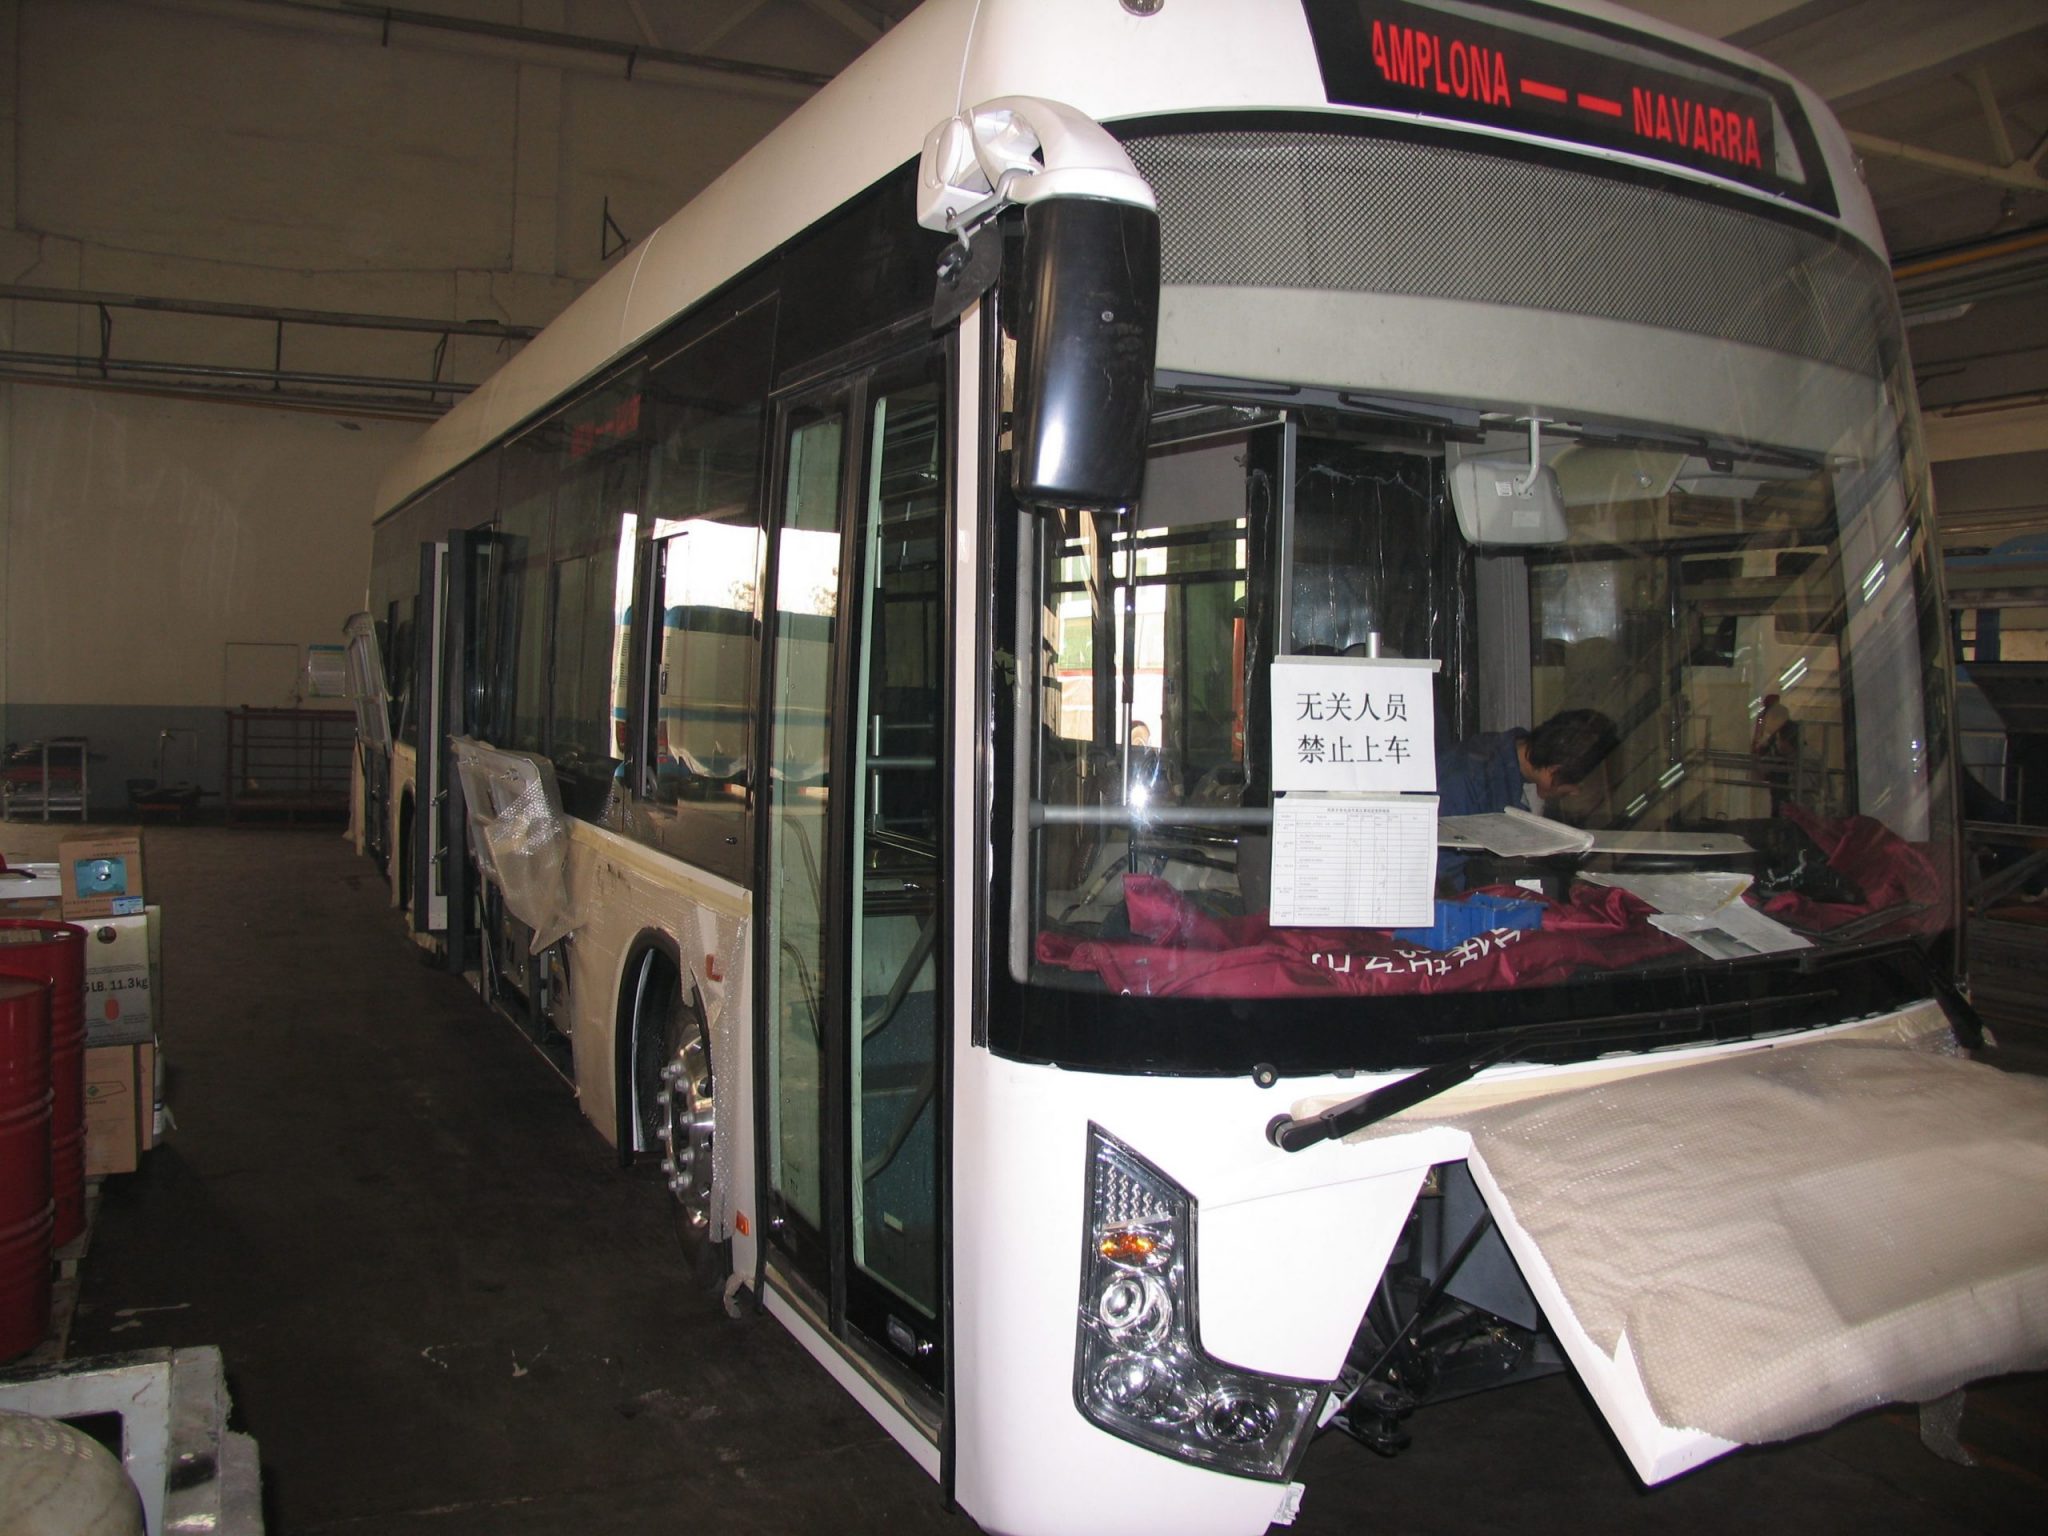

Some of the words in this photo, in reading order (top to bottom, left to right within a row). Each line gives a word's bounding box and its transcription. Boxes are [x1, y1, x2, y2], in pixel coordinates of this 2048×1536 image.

[1372, 19, 1511, 108] AMPLONA
[1632, 86, 1761, 169] NAVARRA
[1296, 692, 1408, 722] 无关人员
[1297, 734, 1411, 764] 禁止上车
